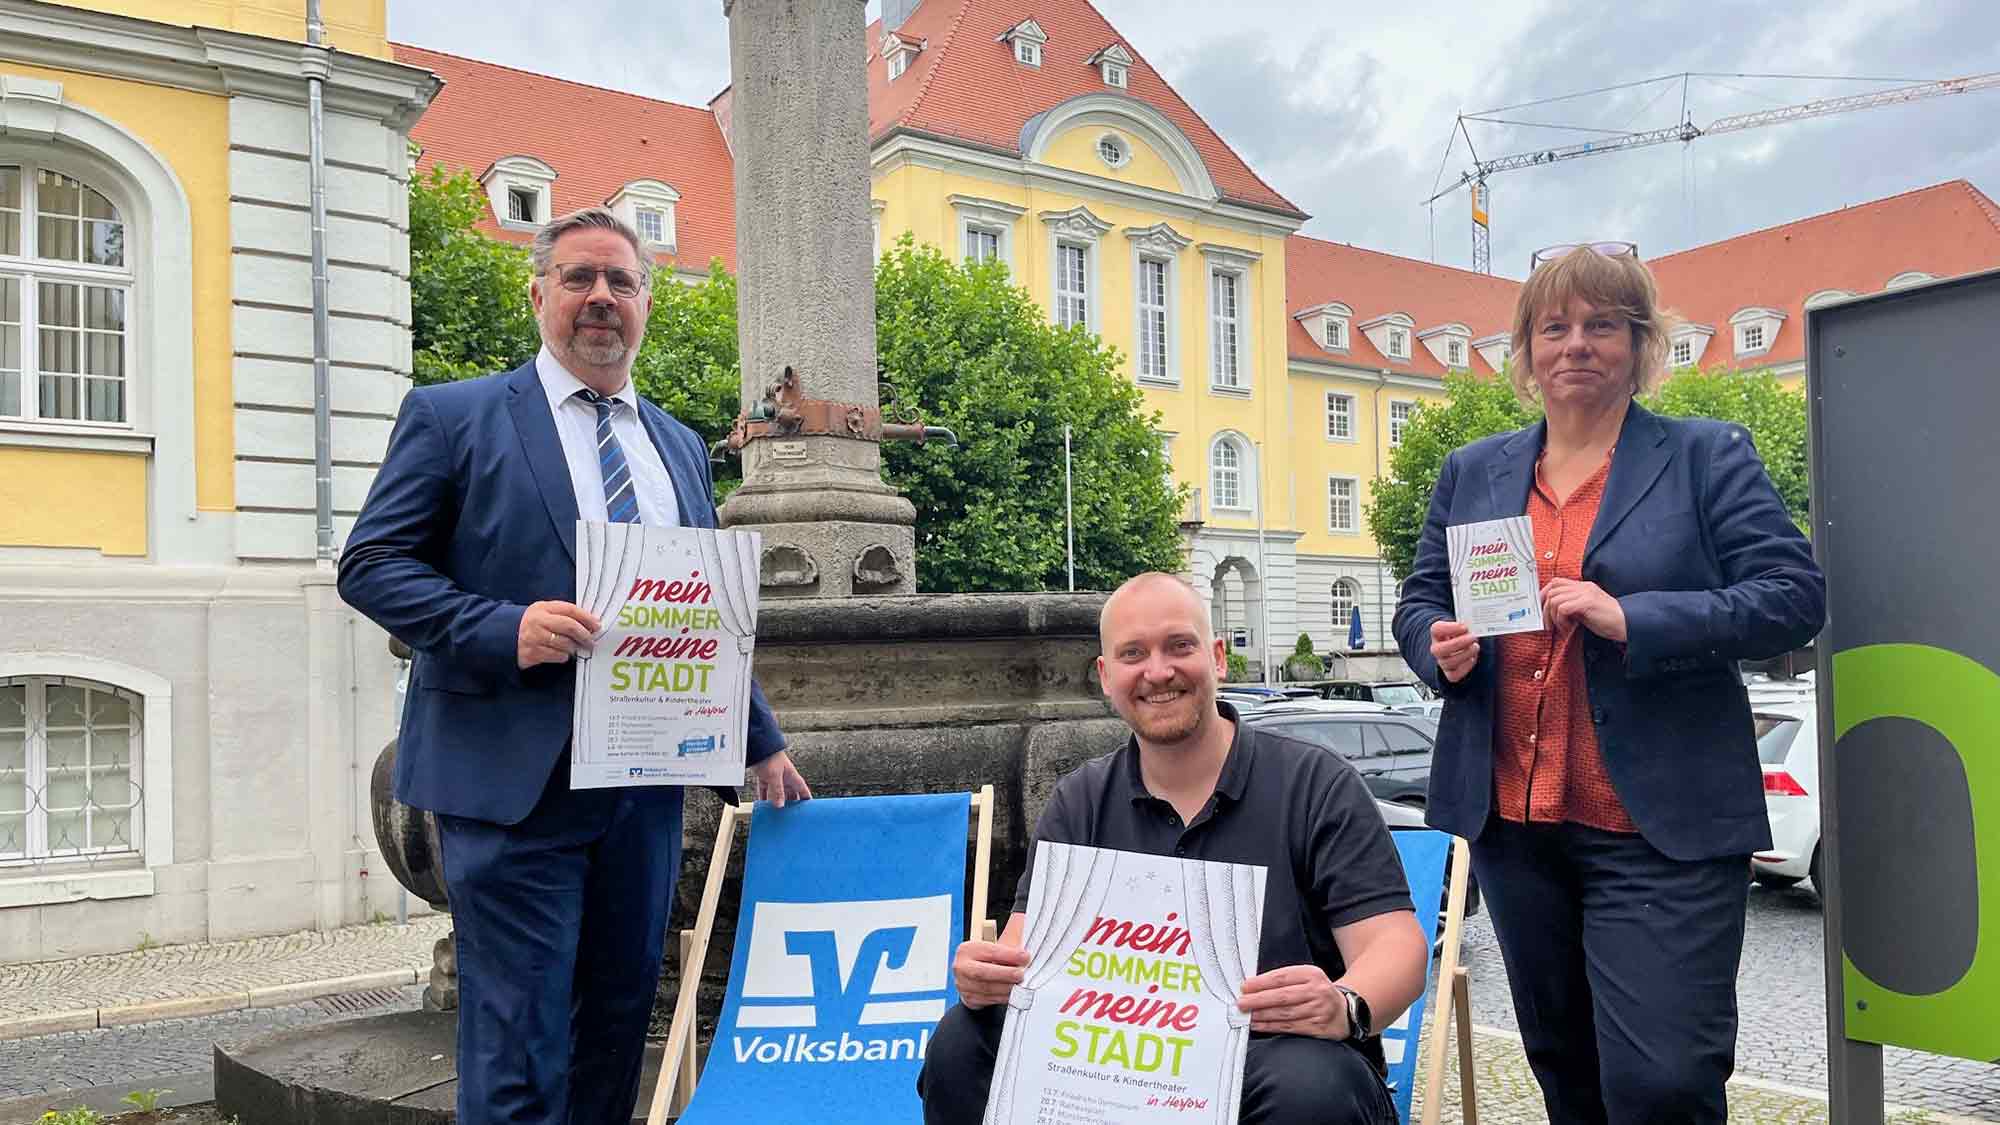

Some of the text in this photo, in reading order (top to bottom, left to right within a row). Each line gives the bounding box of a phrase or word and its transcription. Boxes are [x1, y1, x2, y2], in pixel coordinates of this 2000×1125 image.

[1470, 538, 1508, 556] mein
[627, 570, 712, 605] mein
[1470, 564, 1518, 582] meine
[1470, 578, 1519, 596] STADT
[617, 604, 721, 631] SOMMER
[613, 627, 718, 661] meine
[609, 660, 715, 693] STADT
[658, 696, 664, 704] &
[1083, 912, 1193, 957] mein
[1066, 949, 1201, 993] SOMMER
[1059, 985, 1199, 1032] meine
[1049, 1020, 1194, 1077] STADT
[1047, 1062, 1188, 1093] Straßenkultur & Kindertheater
[1146, 1094, 1159, 1107] in
[1162, 1095, 1209, 1112] Herford
